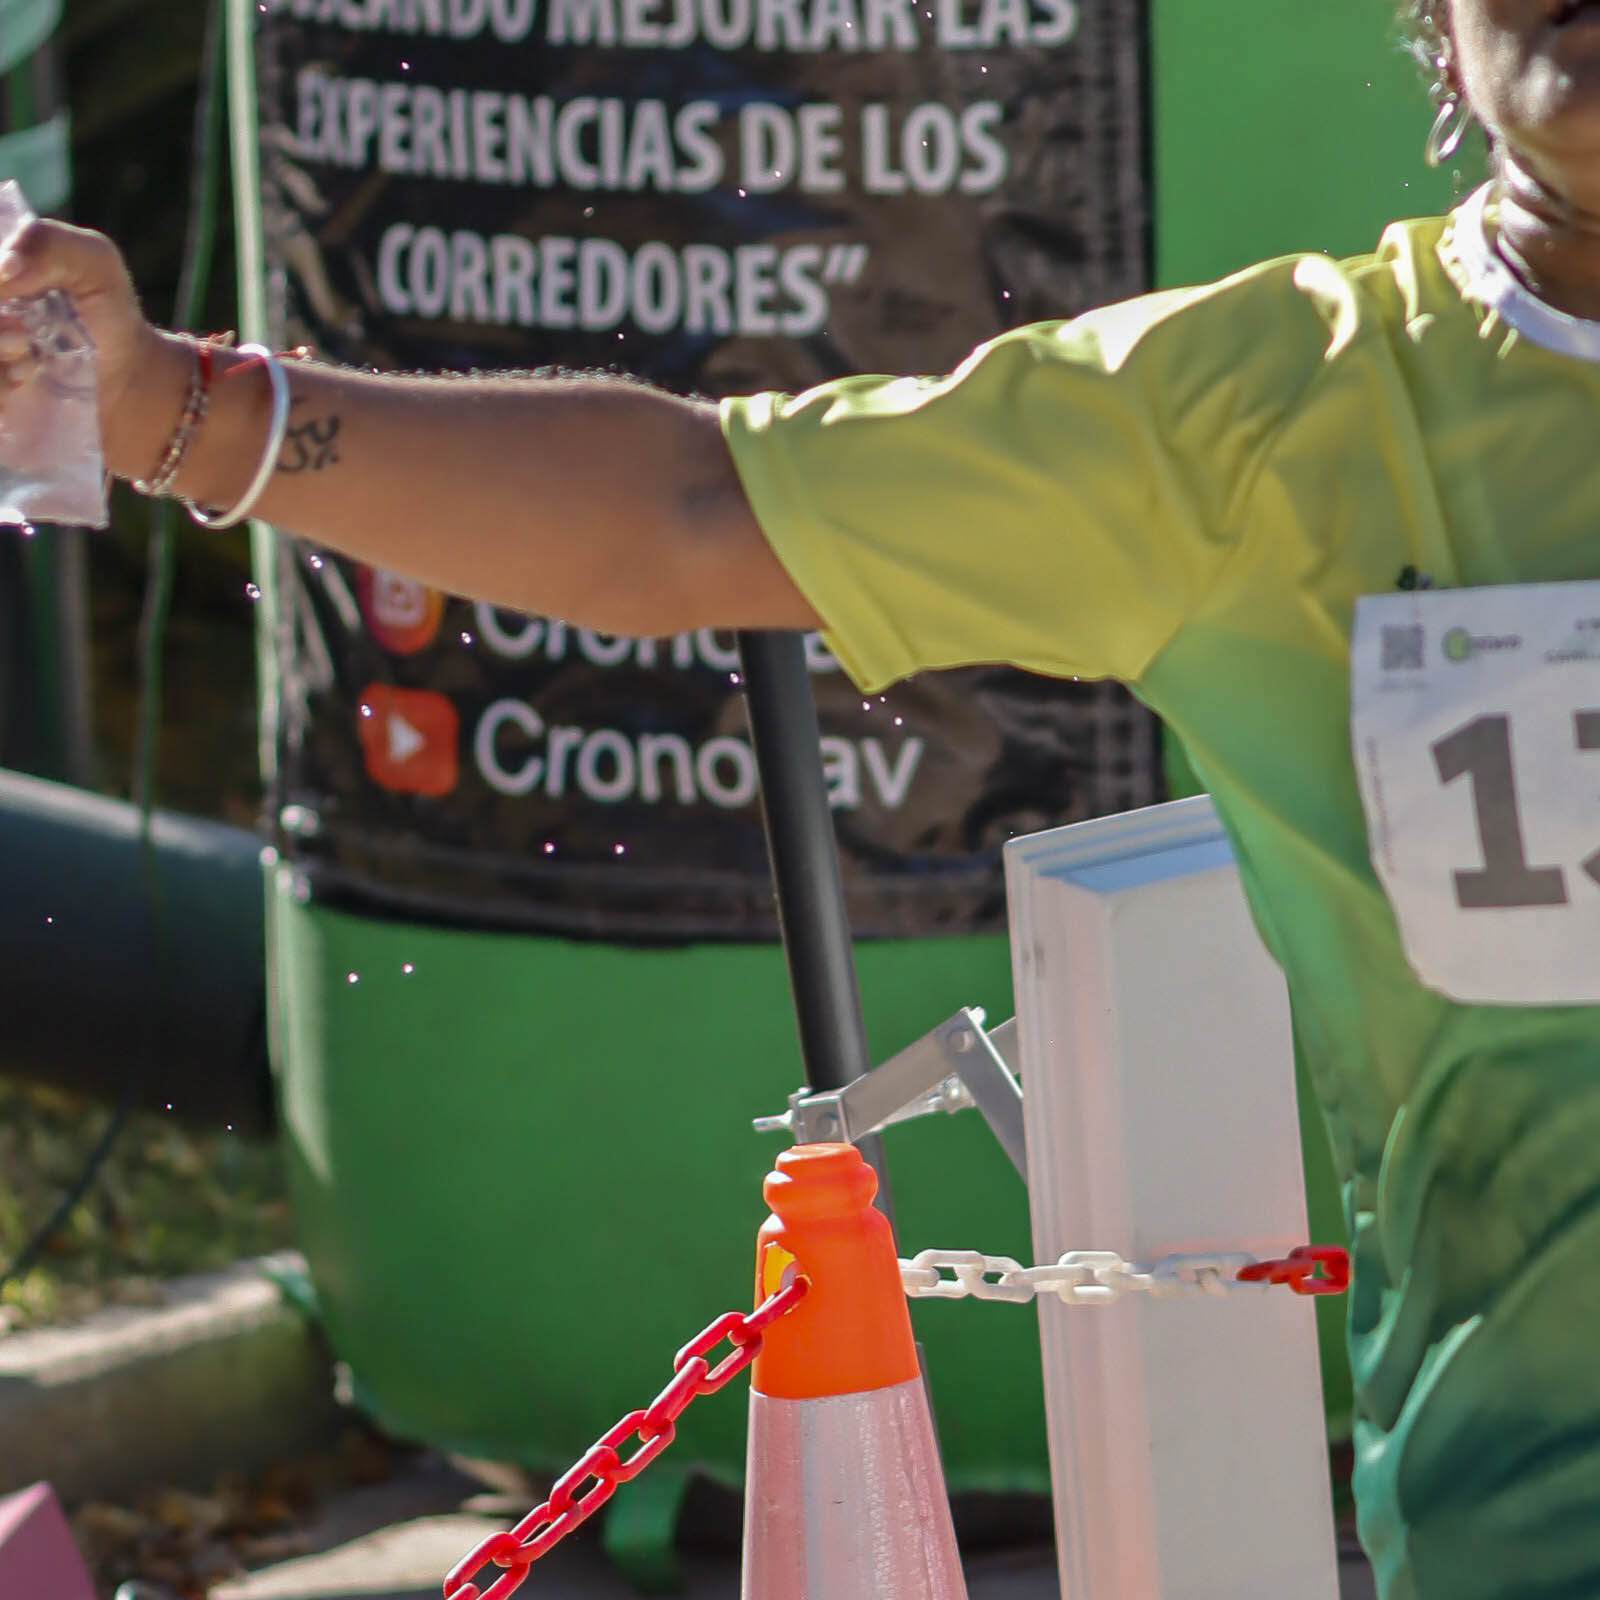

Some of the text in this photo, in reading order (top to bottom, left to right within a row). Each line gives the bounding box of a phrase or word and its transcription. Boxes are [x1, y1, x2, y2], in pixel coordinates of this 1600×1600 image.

[296, 70, 1008, 194] EXPERIENCIAS DE LOS
[475, 698, 923, 808] Cronoav
